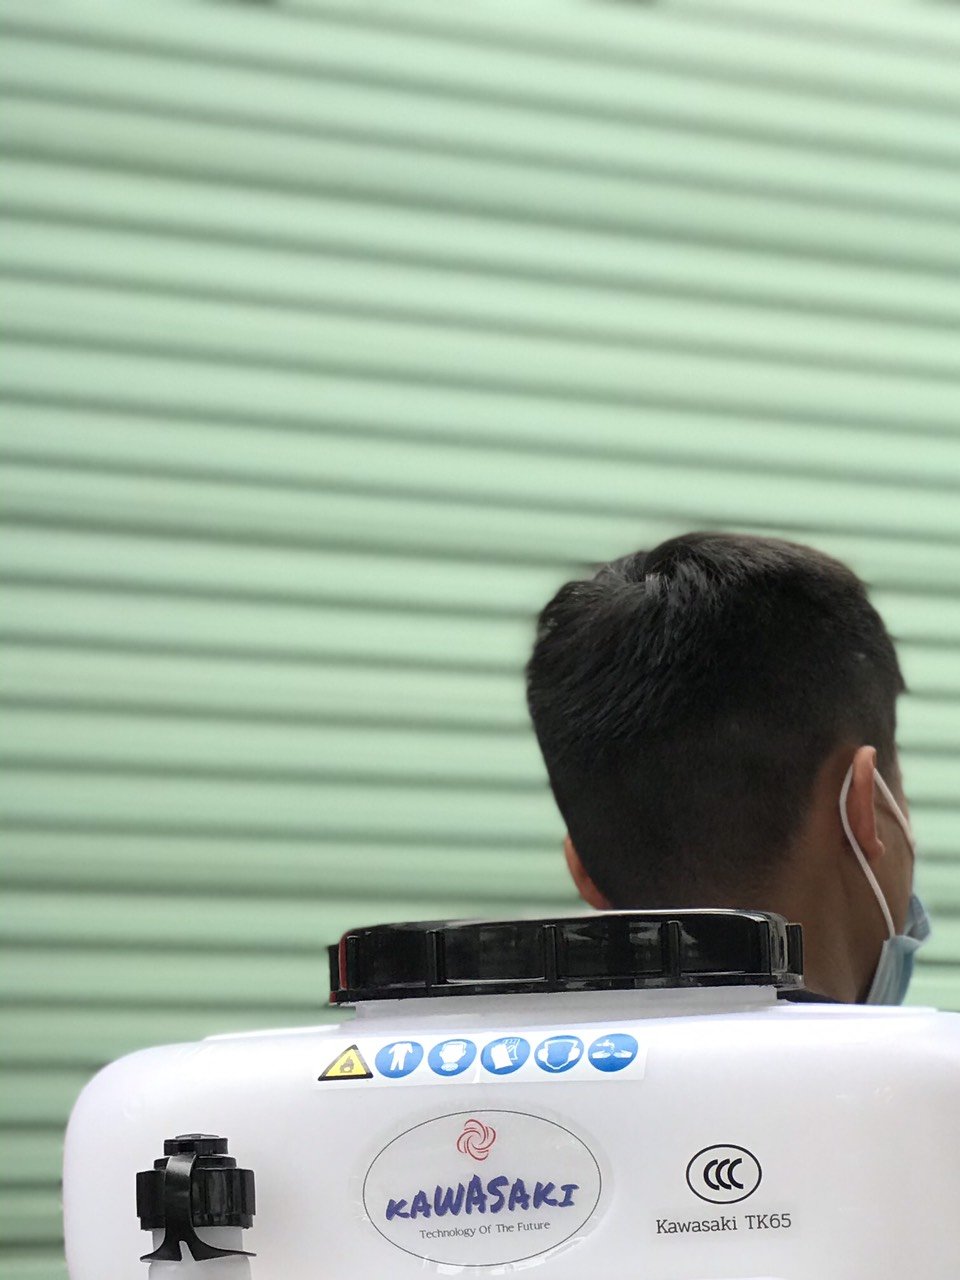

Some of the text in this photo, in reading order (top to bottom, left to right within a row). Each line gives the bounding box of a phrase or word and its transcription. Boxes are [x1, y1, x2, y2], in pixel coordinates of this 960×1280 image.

[385, 1174, 580, 1221] KAWASAKI
[419, 1220, 551, 1240] Technology Of The Future
[656, 1213, 792, 1234] Kawasaki TK65
